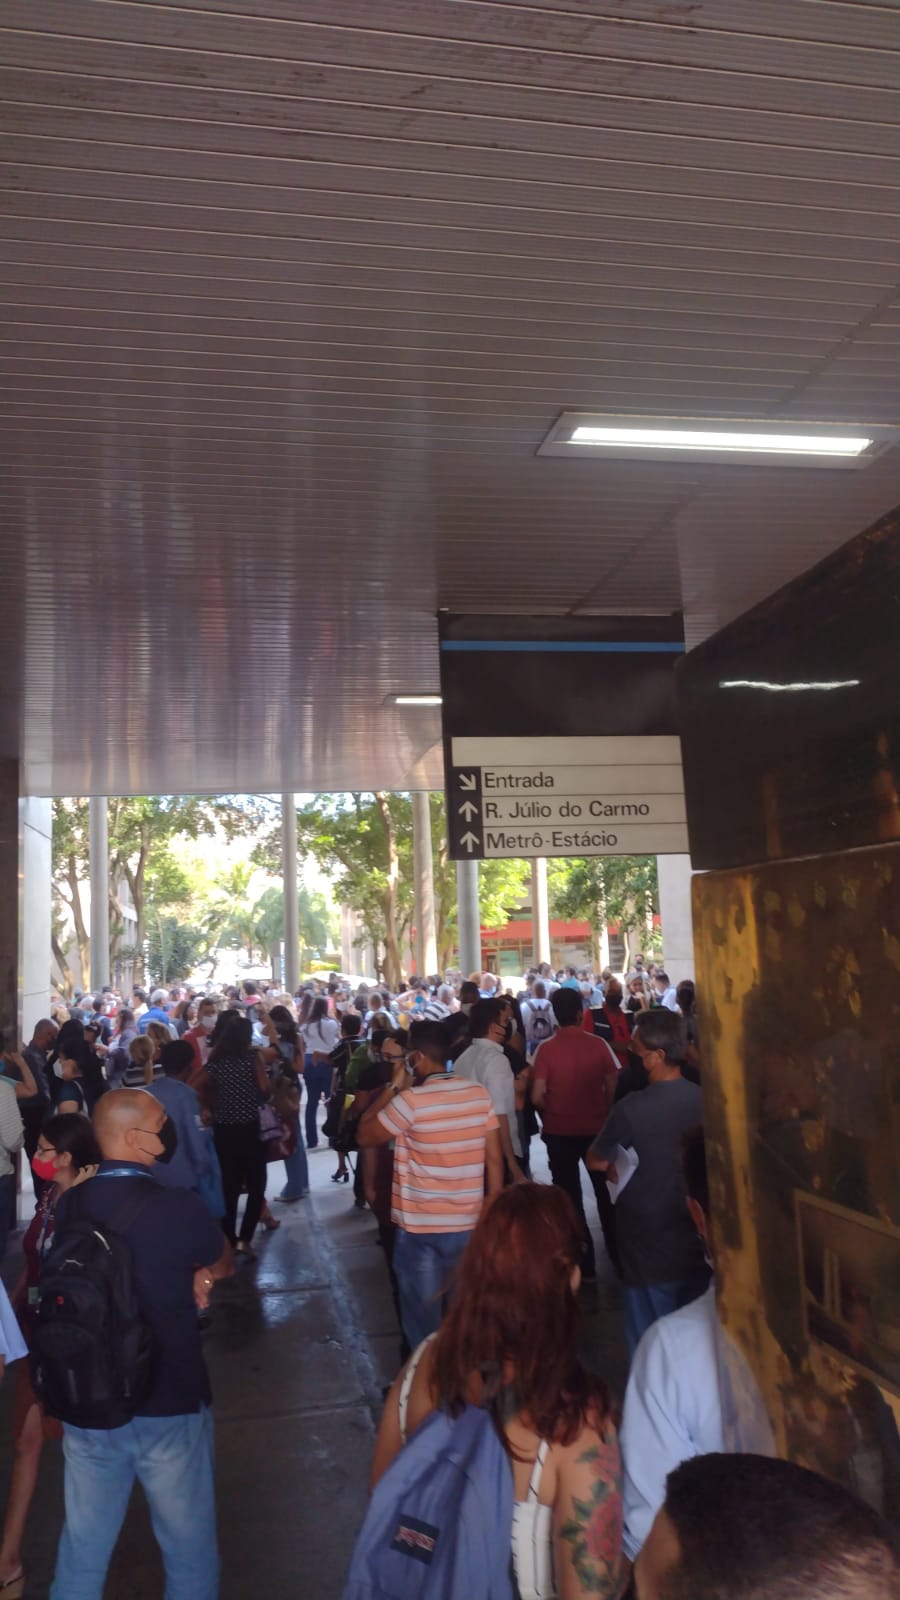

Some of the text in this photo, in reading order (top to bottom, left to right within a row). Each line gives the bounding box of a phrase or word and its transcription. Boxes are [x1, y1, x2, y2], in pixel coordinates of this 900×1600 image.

[484, 772, 555, 788] Entrada
[485, 800, 650, 819] R. Júlio do Carmo
